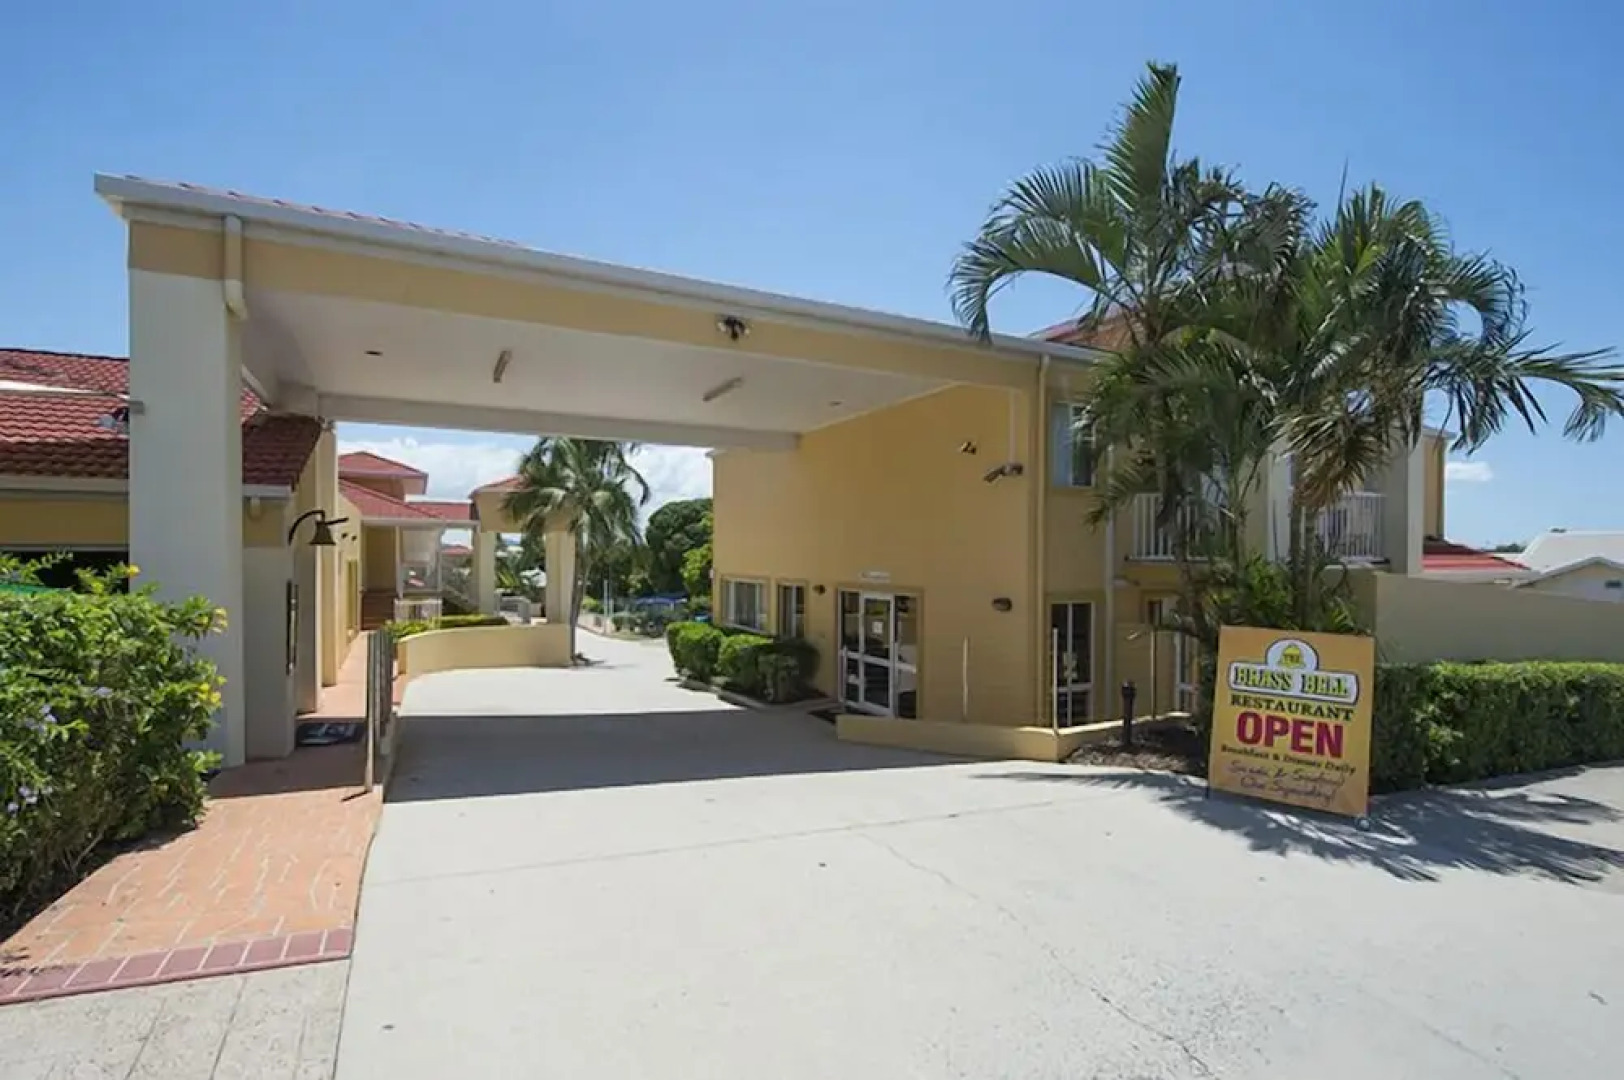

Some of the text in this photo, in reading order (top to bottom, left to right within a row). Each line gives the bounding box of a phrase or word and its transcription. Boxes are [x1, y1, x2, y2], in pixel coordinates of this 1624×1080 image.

[1234, 667, 1349, 695] BRASS BELL
[1231, 694, 1354, 721] RESTAURANT
[1237, 711, 1344, 758] OPEN
[1325, 762, 1356, 775] Daily
